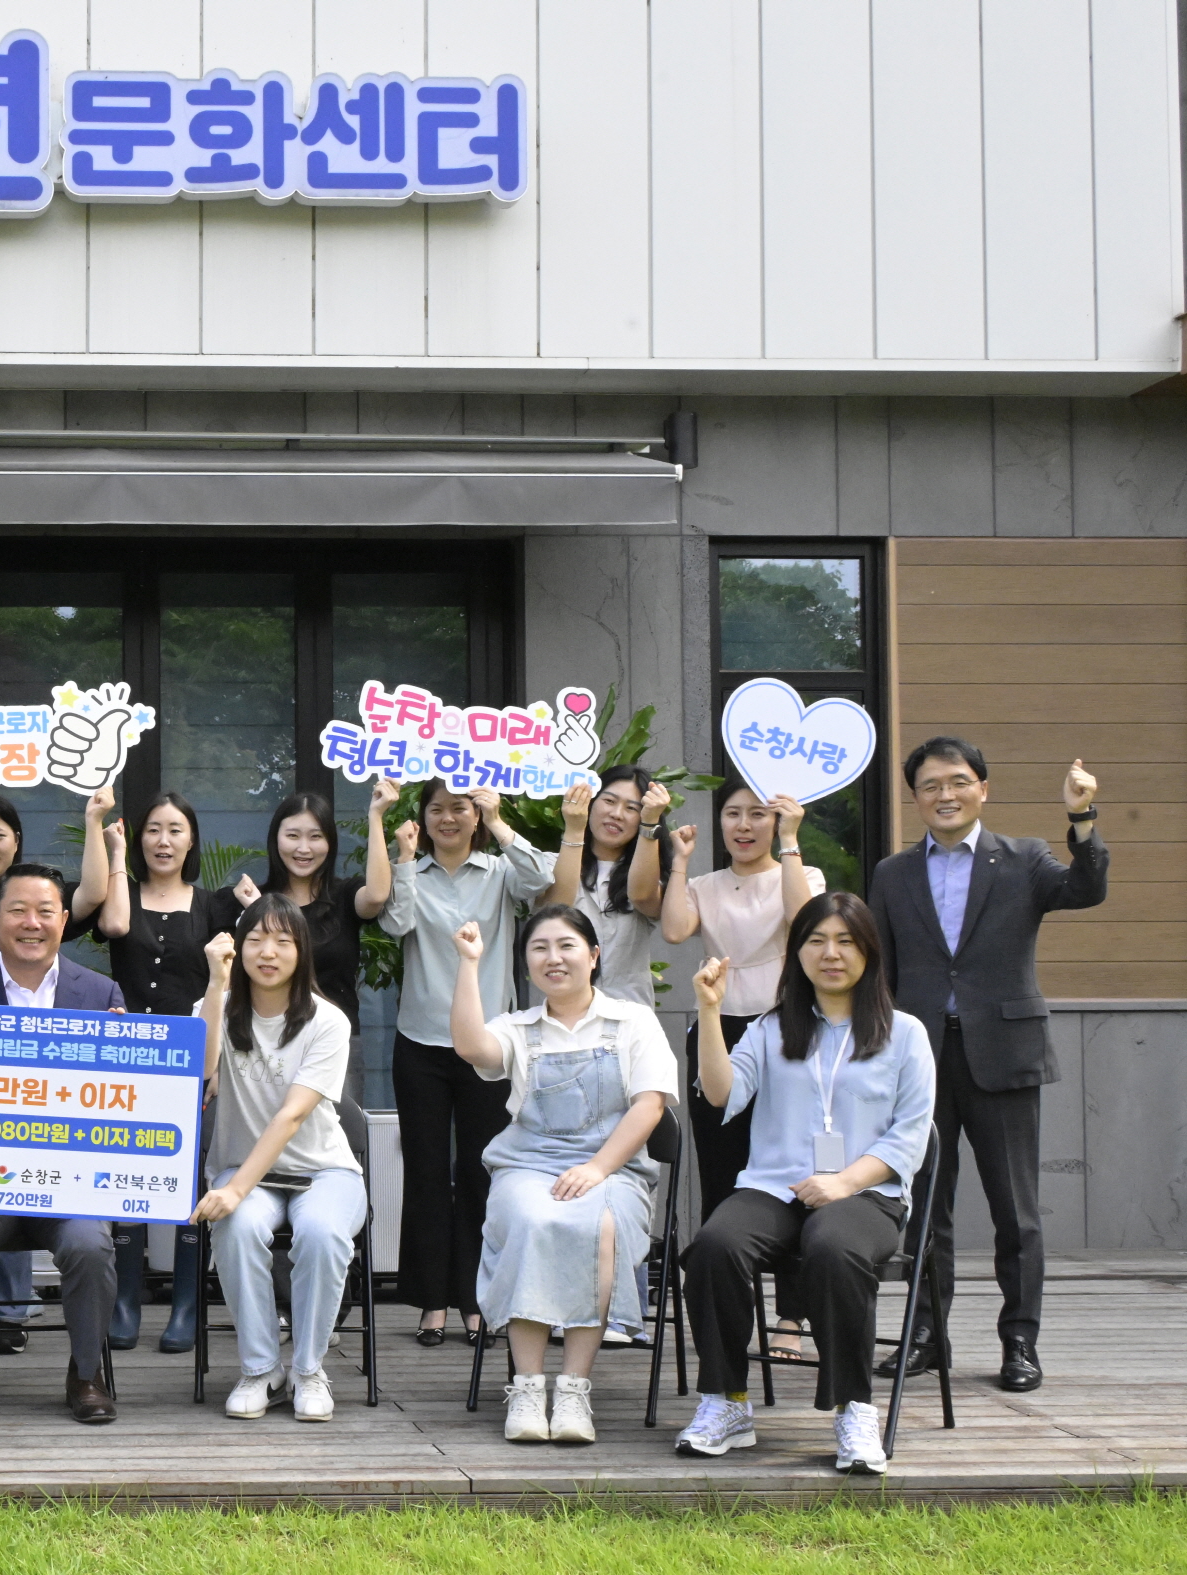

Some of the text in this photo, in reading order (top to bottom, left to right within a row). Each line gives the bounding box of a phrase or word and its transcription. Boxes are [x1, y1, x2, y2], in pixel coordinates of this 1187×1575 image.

[69, 76, 520, 193] 문화센터
[364, 686, 552, 747] 순창의 미래
[325, 725, 597, 793] 청년이 함께합니다
[739, 721, 848, 775] 순창사랑
[20, 1015, 101, 1037] 청년근로자
[104, 1020, 170, 1041] 종자통장
[42, 1041, 97, 1063] 수령을
[100, 1044, 191, 1068] 축하합니다
[55, 1085, 72, 1103] +
[79, 1082, 138, 1112] 이자
[73, 1128, 86, 1141] +
[90, 1125, 131, 1148] 이자
[134, 1128, 176, 1151] 혜택
[20, 1168, 62, 1185] 순창군
[113, 1173, 179, 1193] 전북은행
[122, 1199, 151, 1214] 이자
